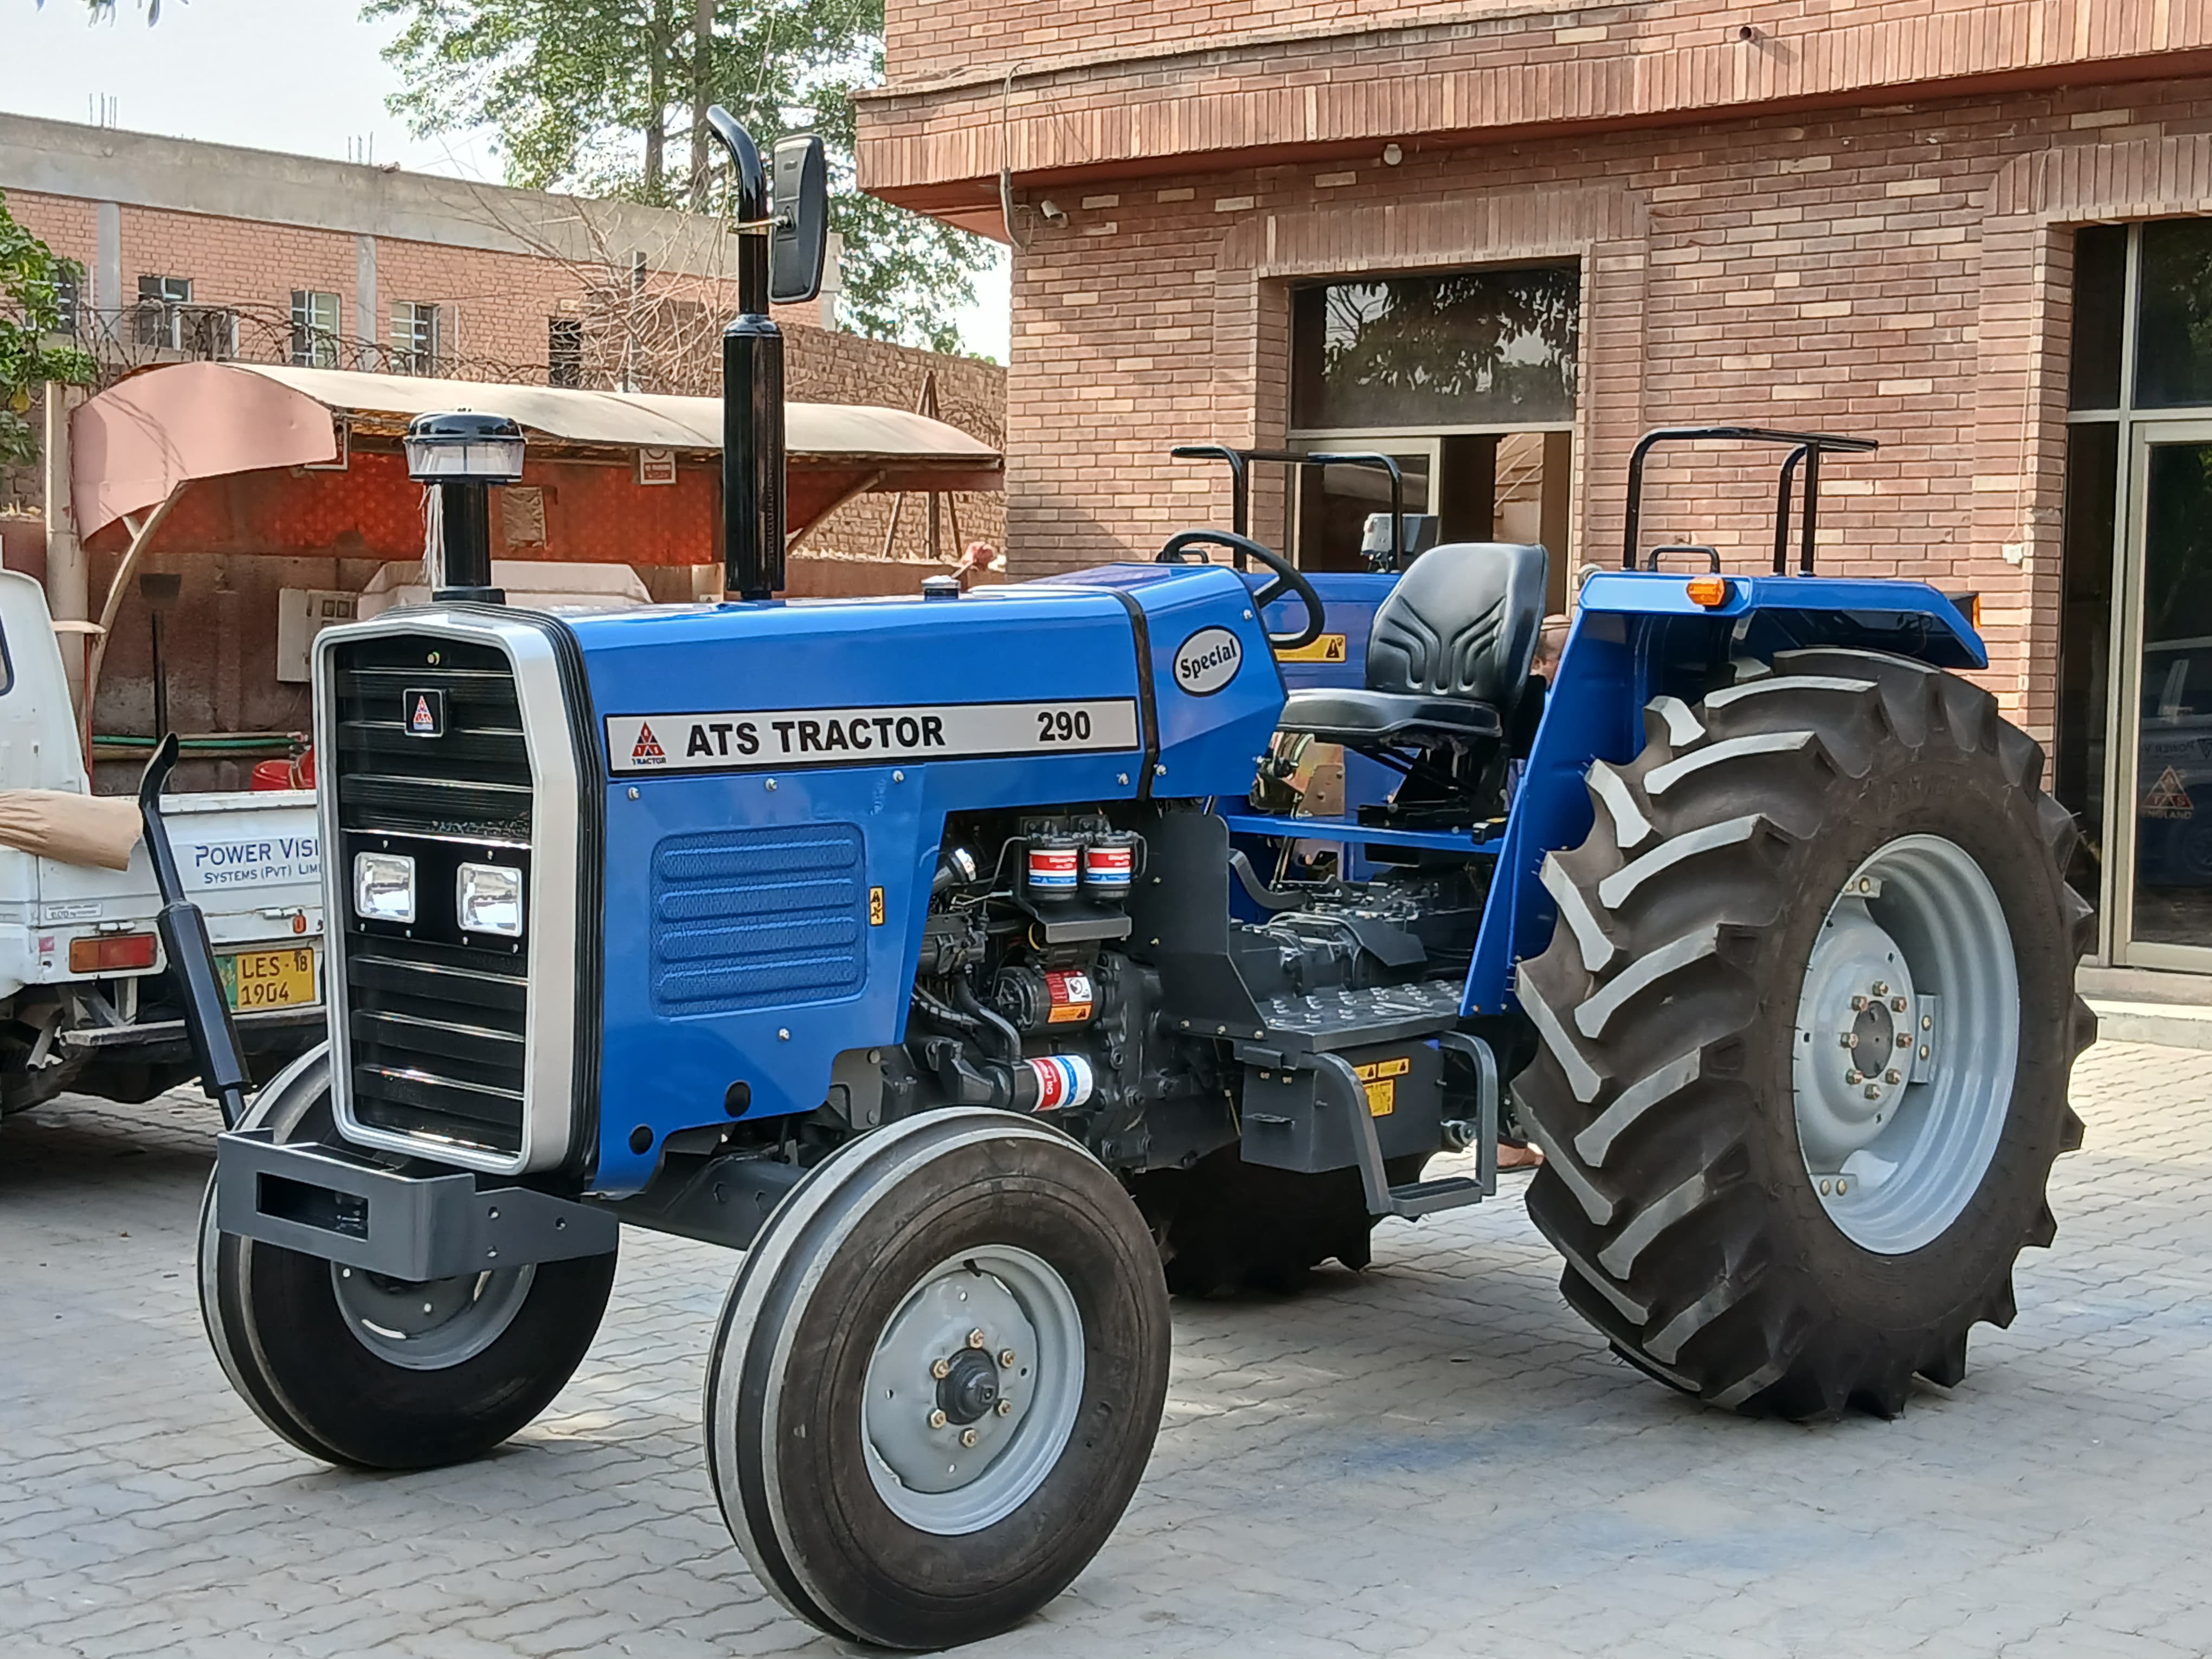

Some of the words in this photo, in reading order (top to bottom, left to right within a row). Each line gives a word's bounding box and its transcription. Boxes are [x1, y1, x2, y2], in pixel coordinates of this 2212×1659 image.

[1180, 638, 1237, 679] Special
[686, 722, 760, 757] ATS
[771, 716, 947, 753] TRACTOR
[1037, 711, 1091, 742] 290
[632, 757, 666, 765] TRACTOR
[195, 843, 271, 867] POWER
[280, 838, 318, 860] VISI
[204, 869, 258, 884] SYSTEMS
[242, 956, 281, 979] LES
[241, 981, 289, 1006] 1904
